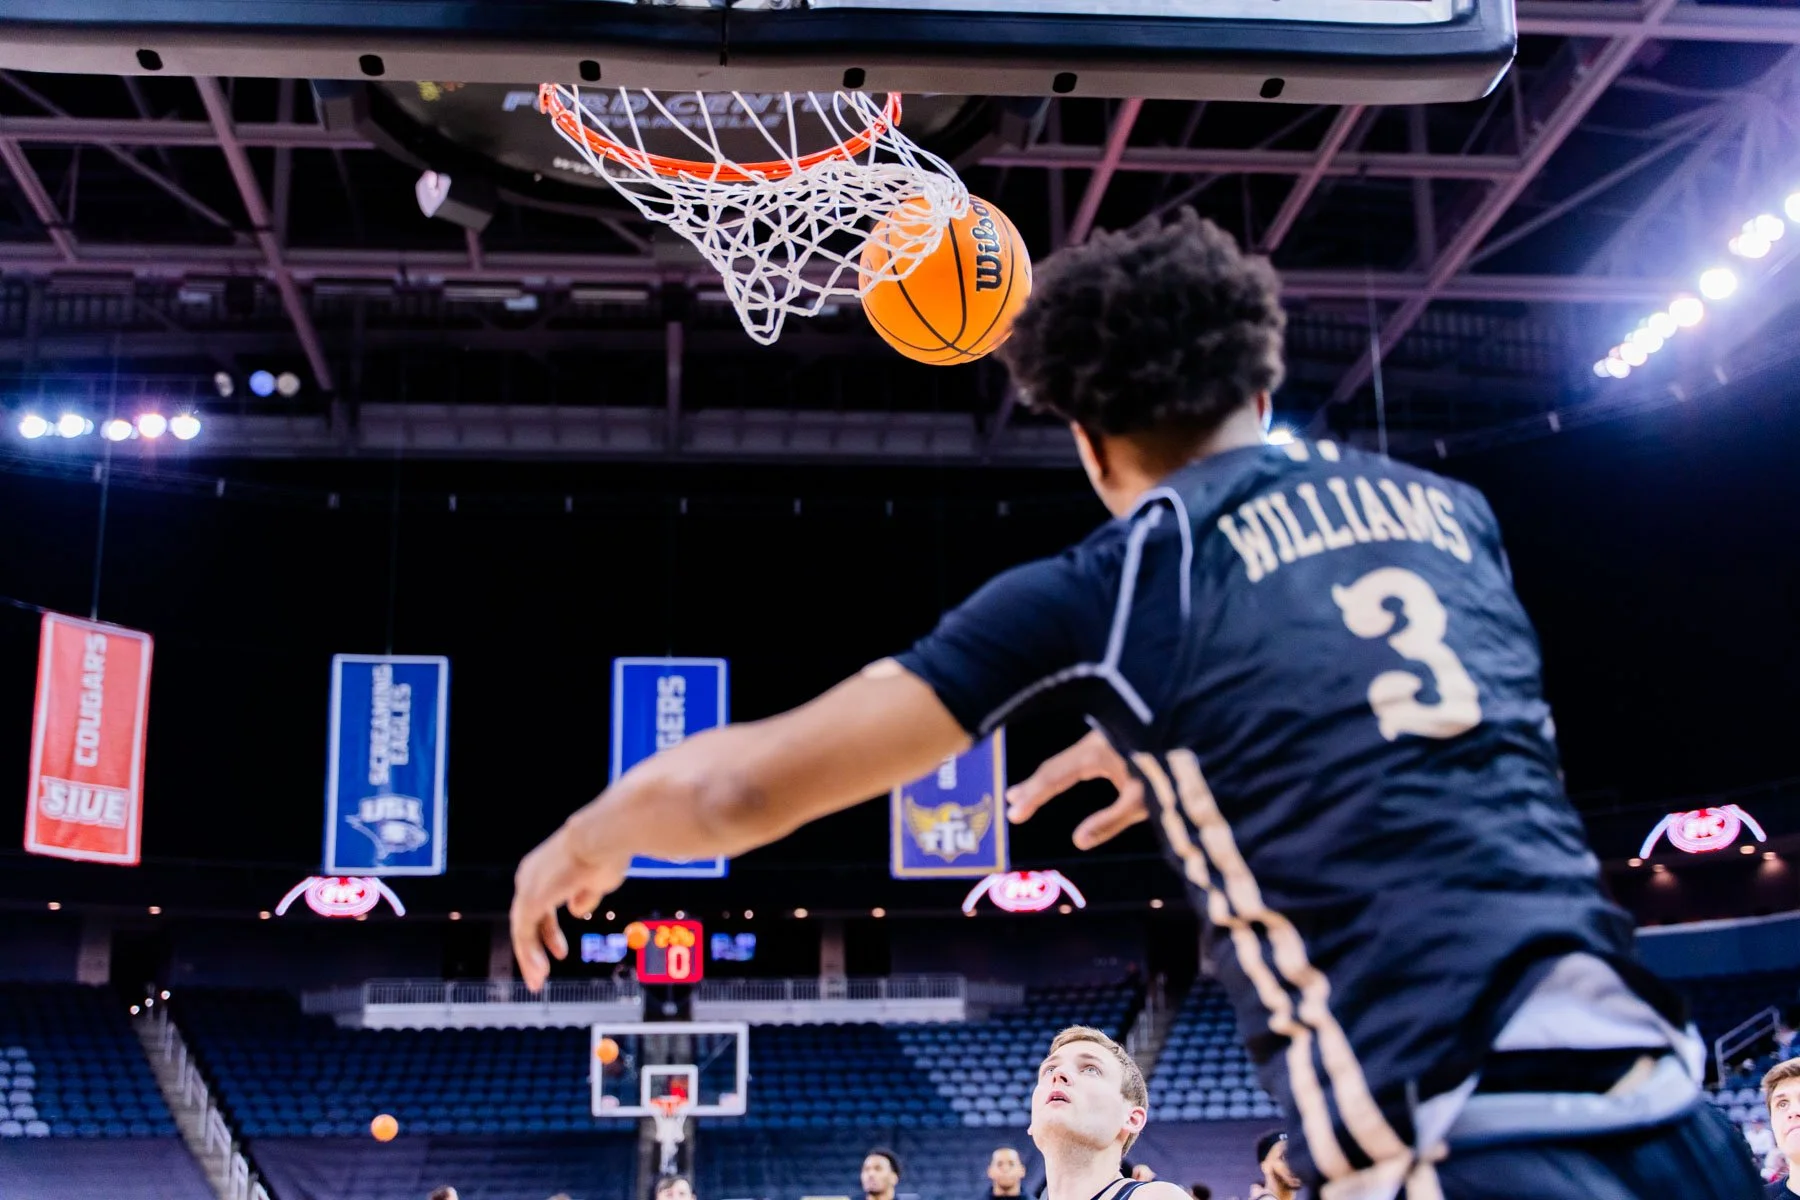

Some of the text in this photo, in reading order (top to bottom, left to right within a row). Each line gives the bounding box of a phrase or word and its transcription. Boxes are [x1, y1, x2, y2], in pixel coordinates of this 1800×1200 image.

[1217, 476, 1472, 582] WILLIAMS
[73, 632, 108, 767] COUGARS
[1331, 566, 1482, 742] 3
[45, 783, 126, 824] SIUE
[667, 944, 691, 980] 0
